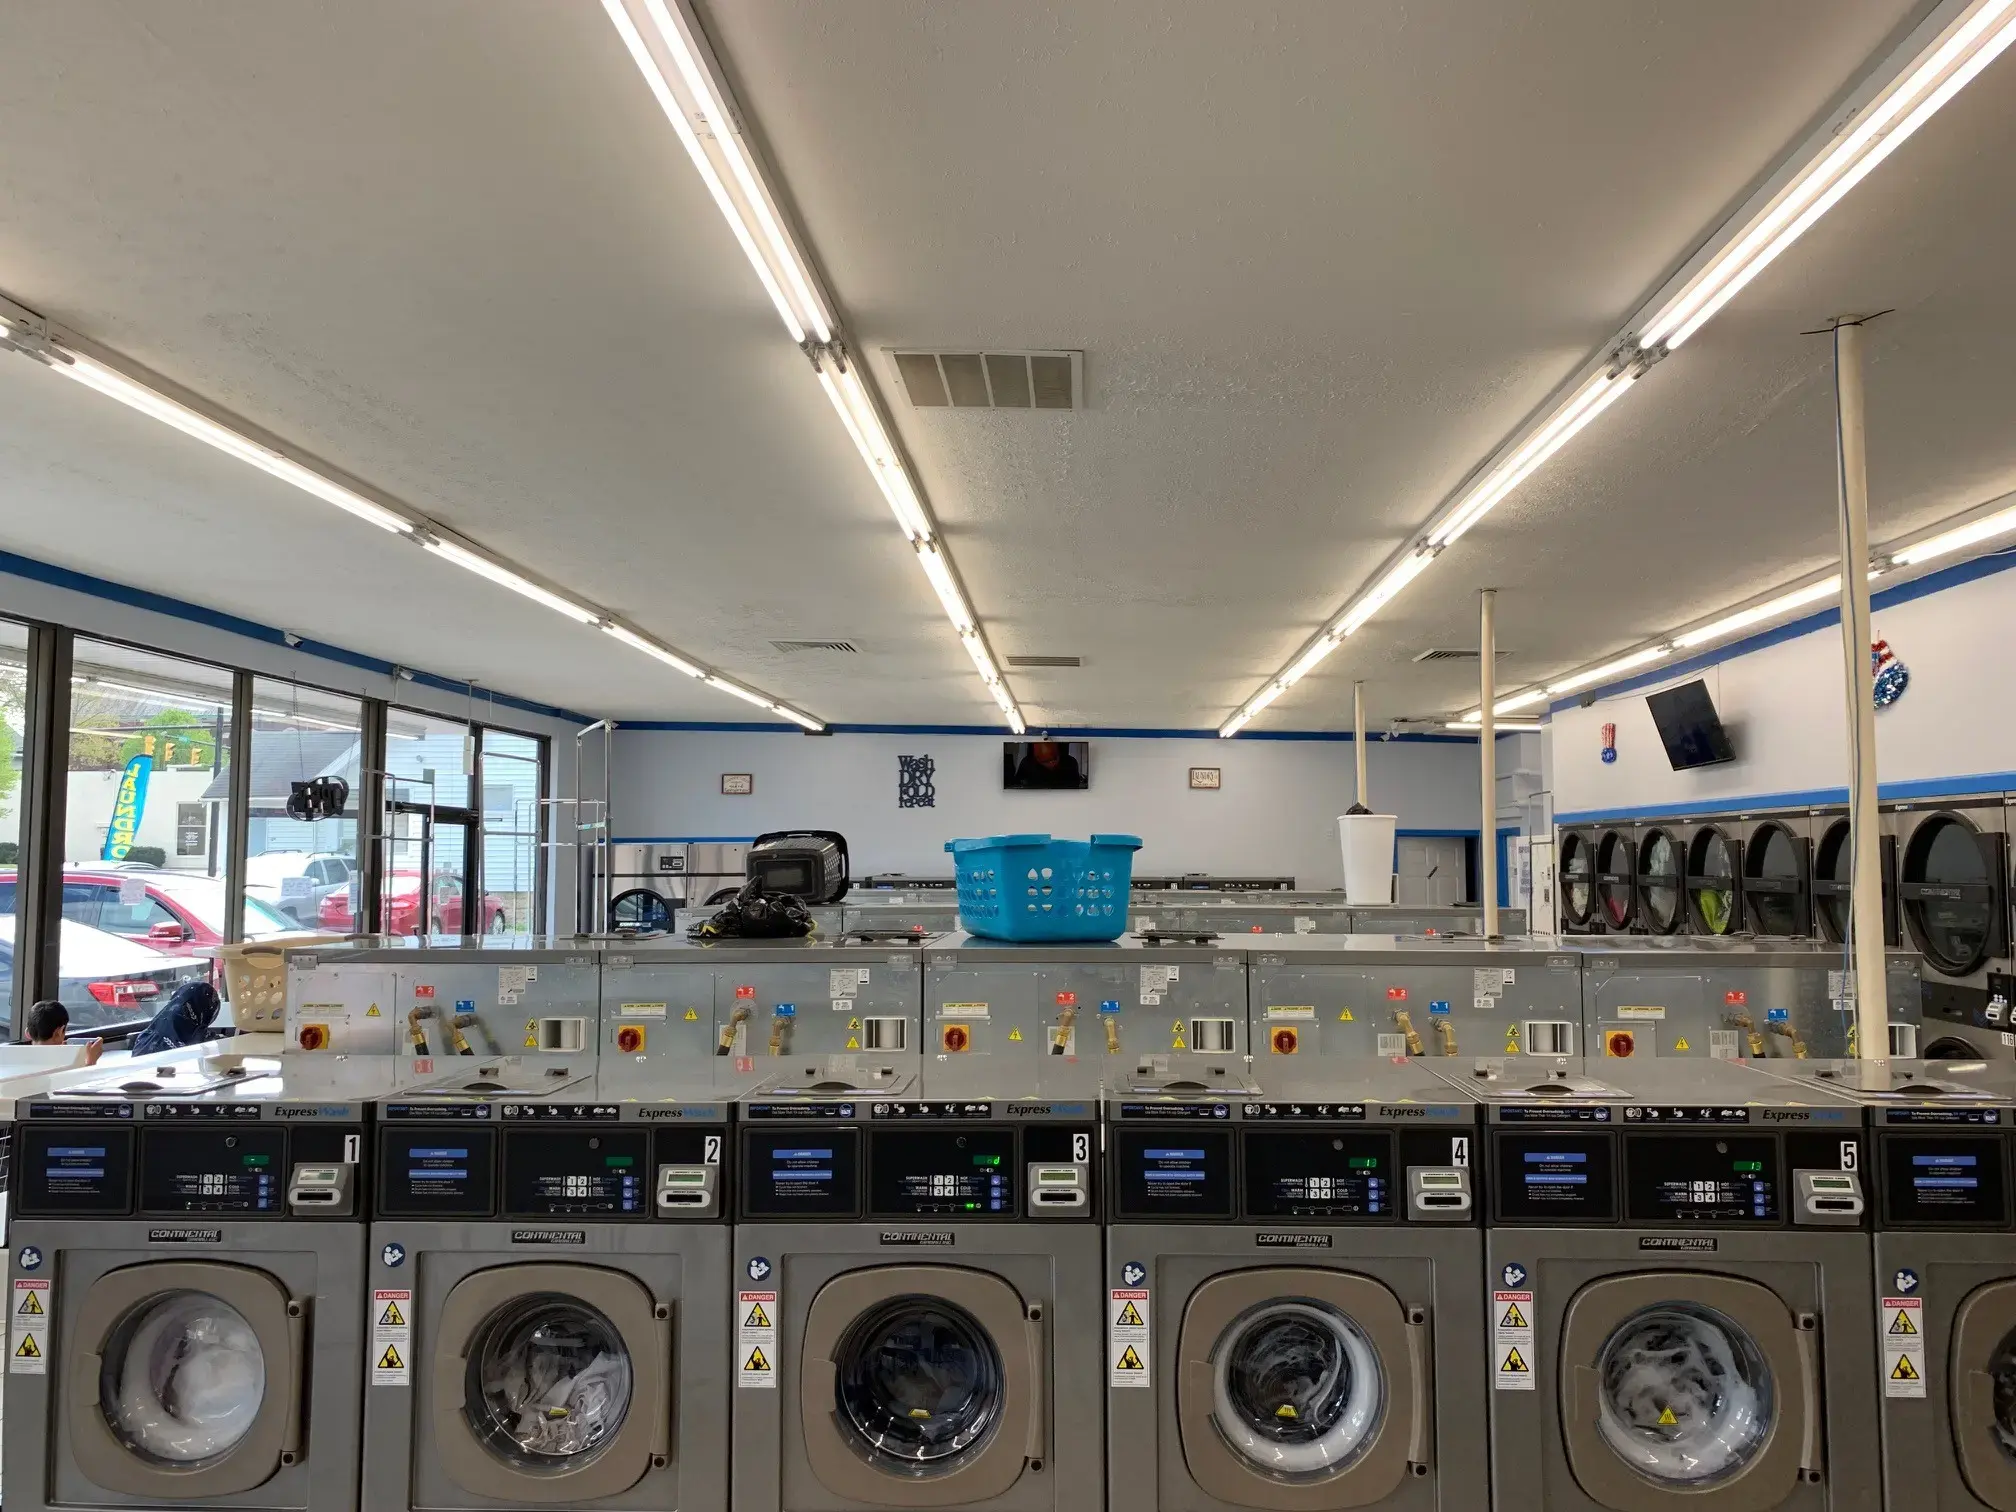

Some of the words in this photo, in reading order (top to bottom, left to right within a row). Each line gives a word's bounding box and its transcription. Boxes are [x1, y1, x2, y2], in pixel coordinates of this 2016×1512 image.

[897, 754, 934, 770] Wash
[898, 769, 936, 786] DRY
[898, 784, 936, 797] FOLD
[898, 796, 936, 808] repeat
[2003, 1033, 2014, 1045] 116
[1006, 1104, 1085, 1116] Express
[1379, 1105, 1460, 1119] Express
[348, 1137, 357, 1162] 1
[707, 1138, 718, 1163] 2
[1075, 1136, 1086, 1162] 3
[1454, 1139, 1466, 1165] 4
[1843, 1143, 1855, 1169] 5
[151, 1230, 218, 1238] CONTINENTAL
[514, 1231, 582, 1239] CONTINENTAL
[882, 1232, 952, 1240] CONTINENTAL
[1258, 1234, 1329, 1242] CONTINENTAL
[1641, 1238, 1715, 1246] CONTINENTAL
